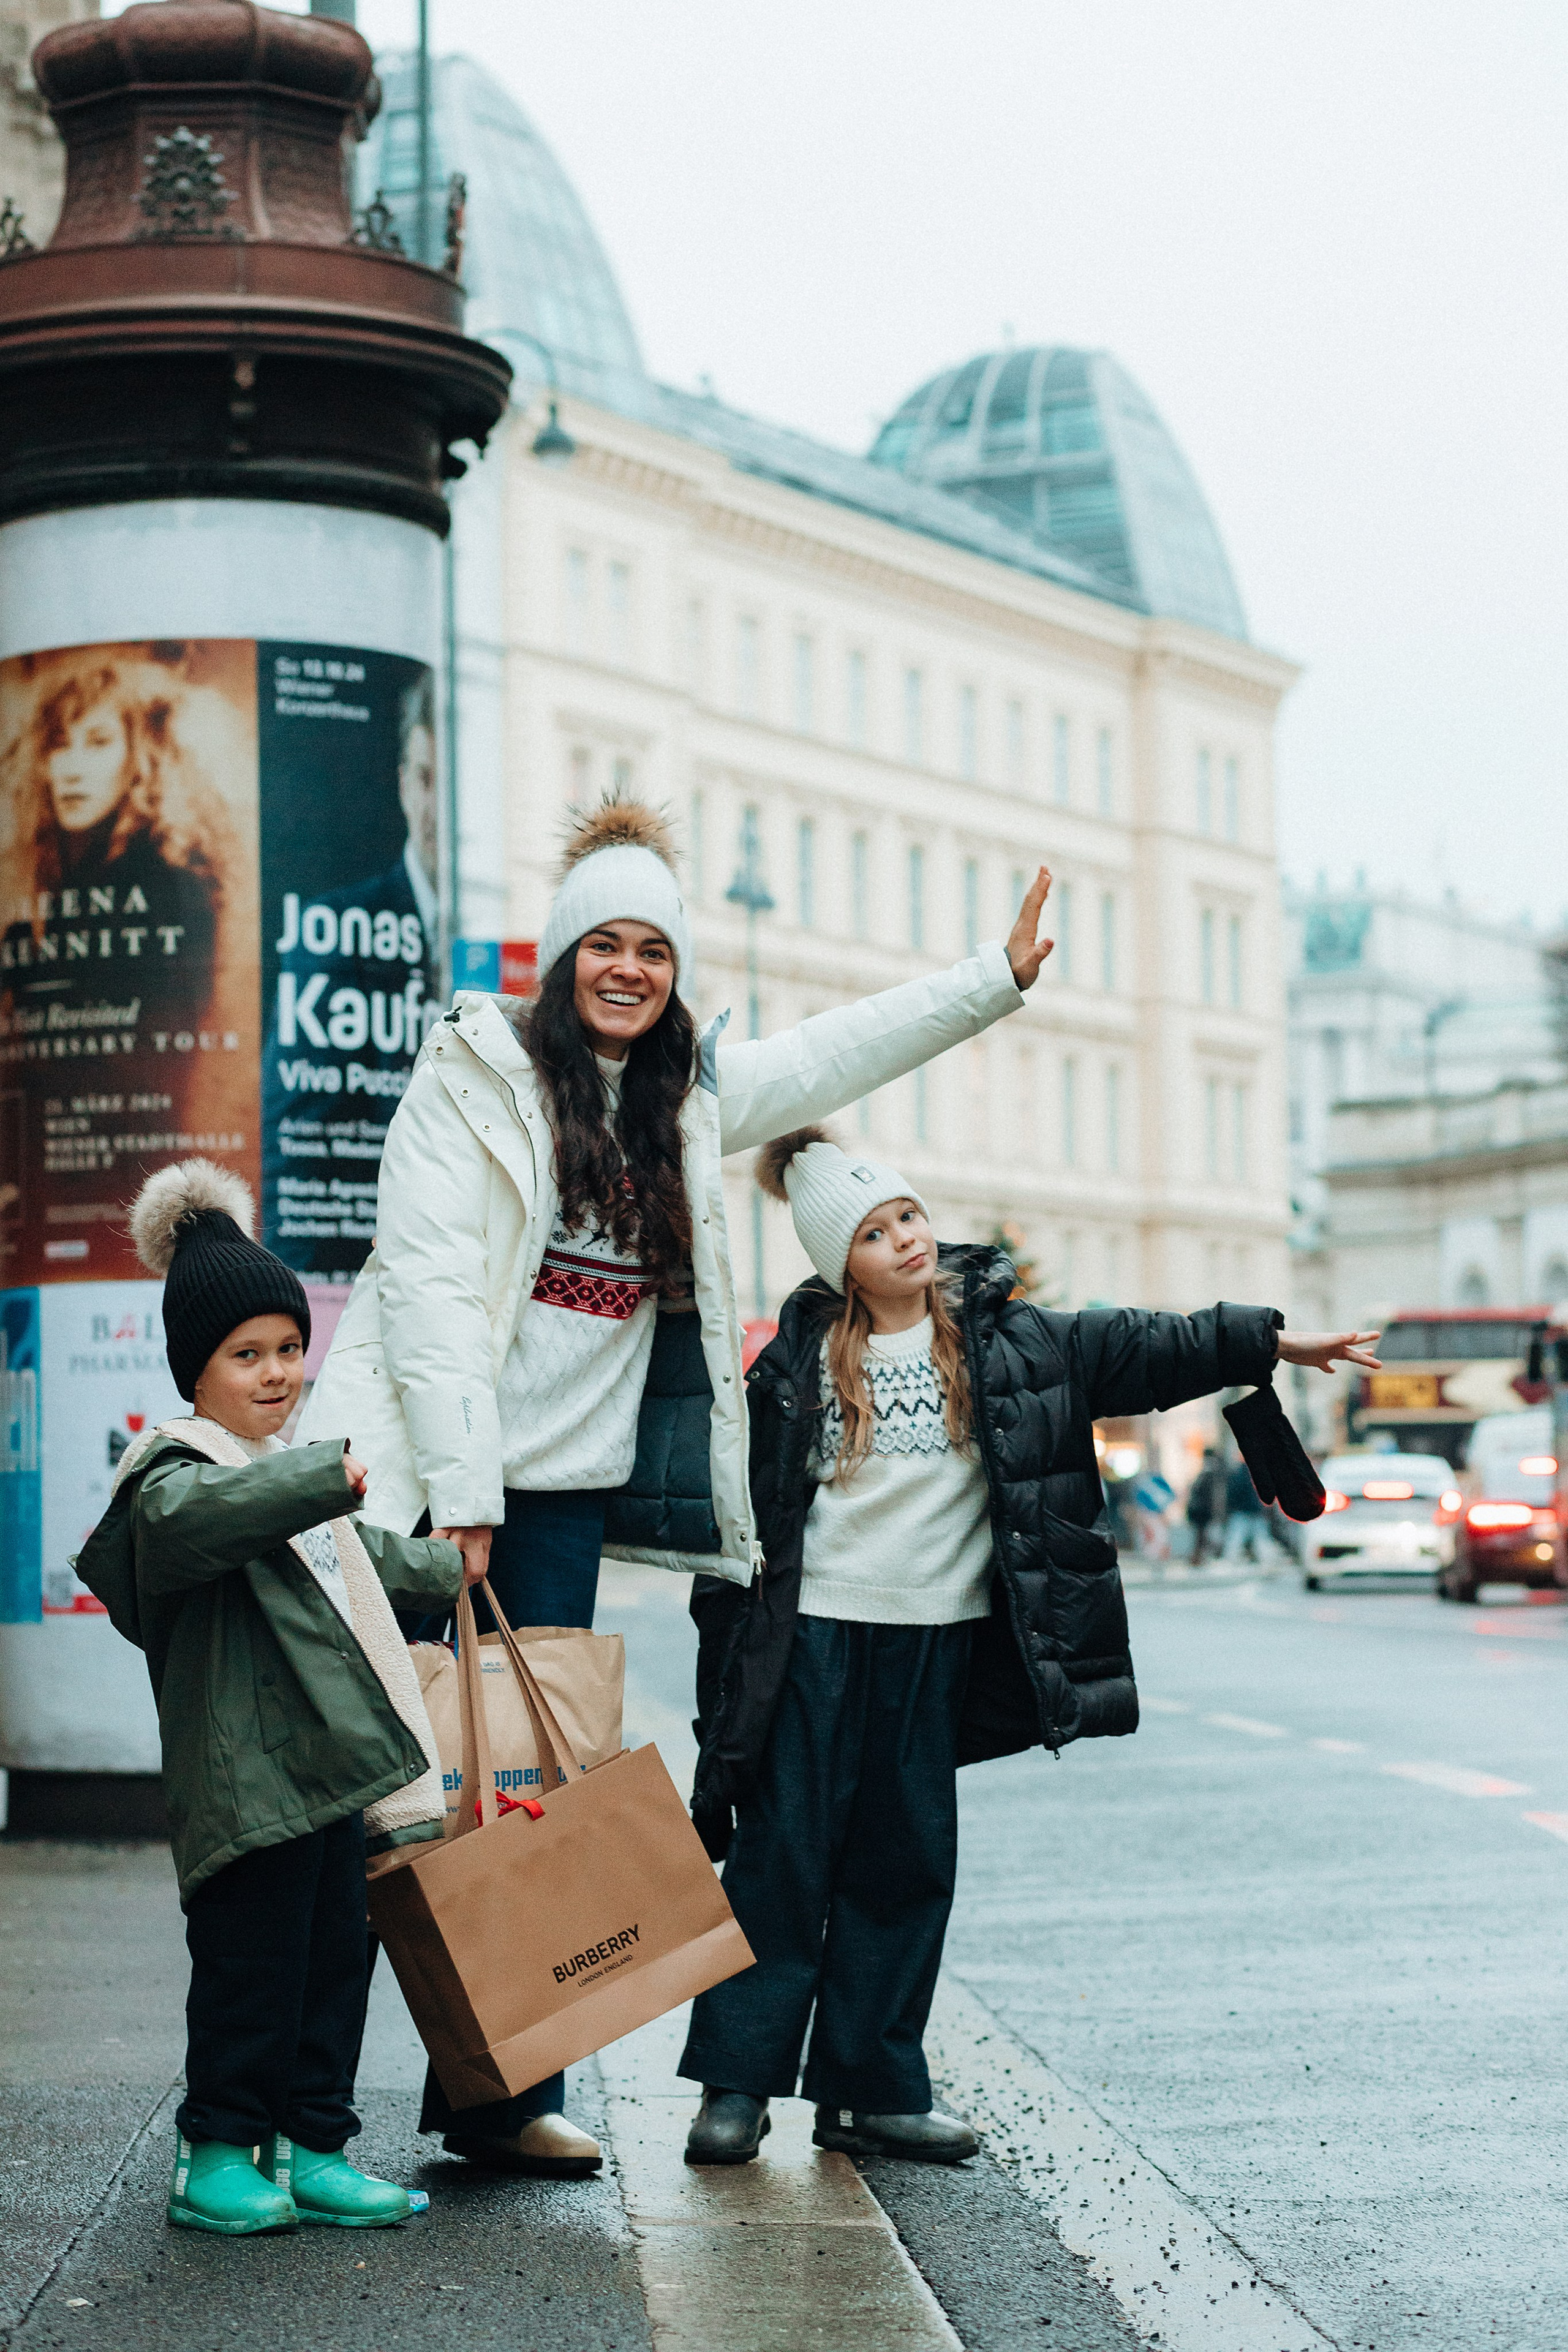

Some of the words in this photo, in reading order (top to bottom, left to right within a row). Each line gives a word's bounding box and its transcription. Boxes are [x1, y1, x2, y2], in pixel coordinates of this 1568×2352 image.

[276, 892, 423, 964] Jonas
[154, 1031, 239, 1053] TOUR
[277, 1060, 342, 1093] Viva
[552, 1924, 641, 1984] BURBERRY
[577, 1969, 605, 1988] LONDON
[604, 1954, 633, 1974] ENGLAND
[175, 2167, 189, 2196] UGG
